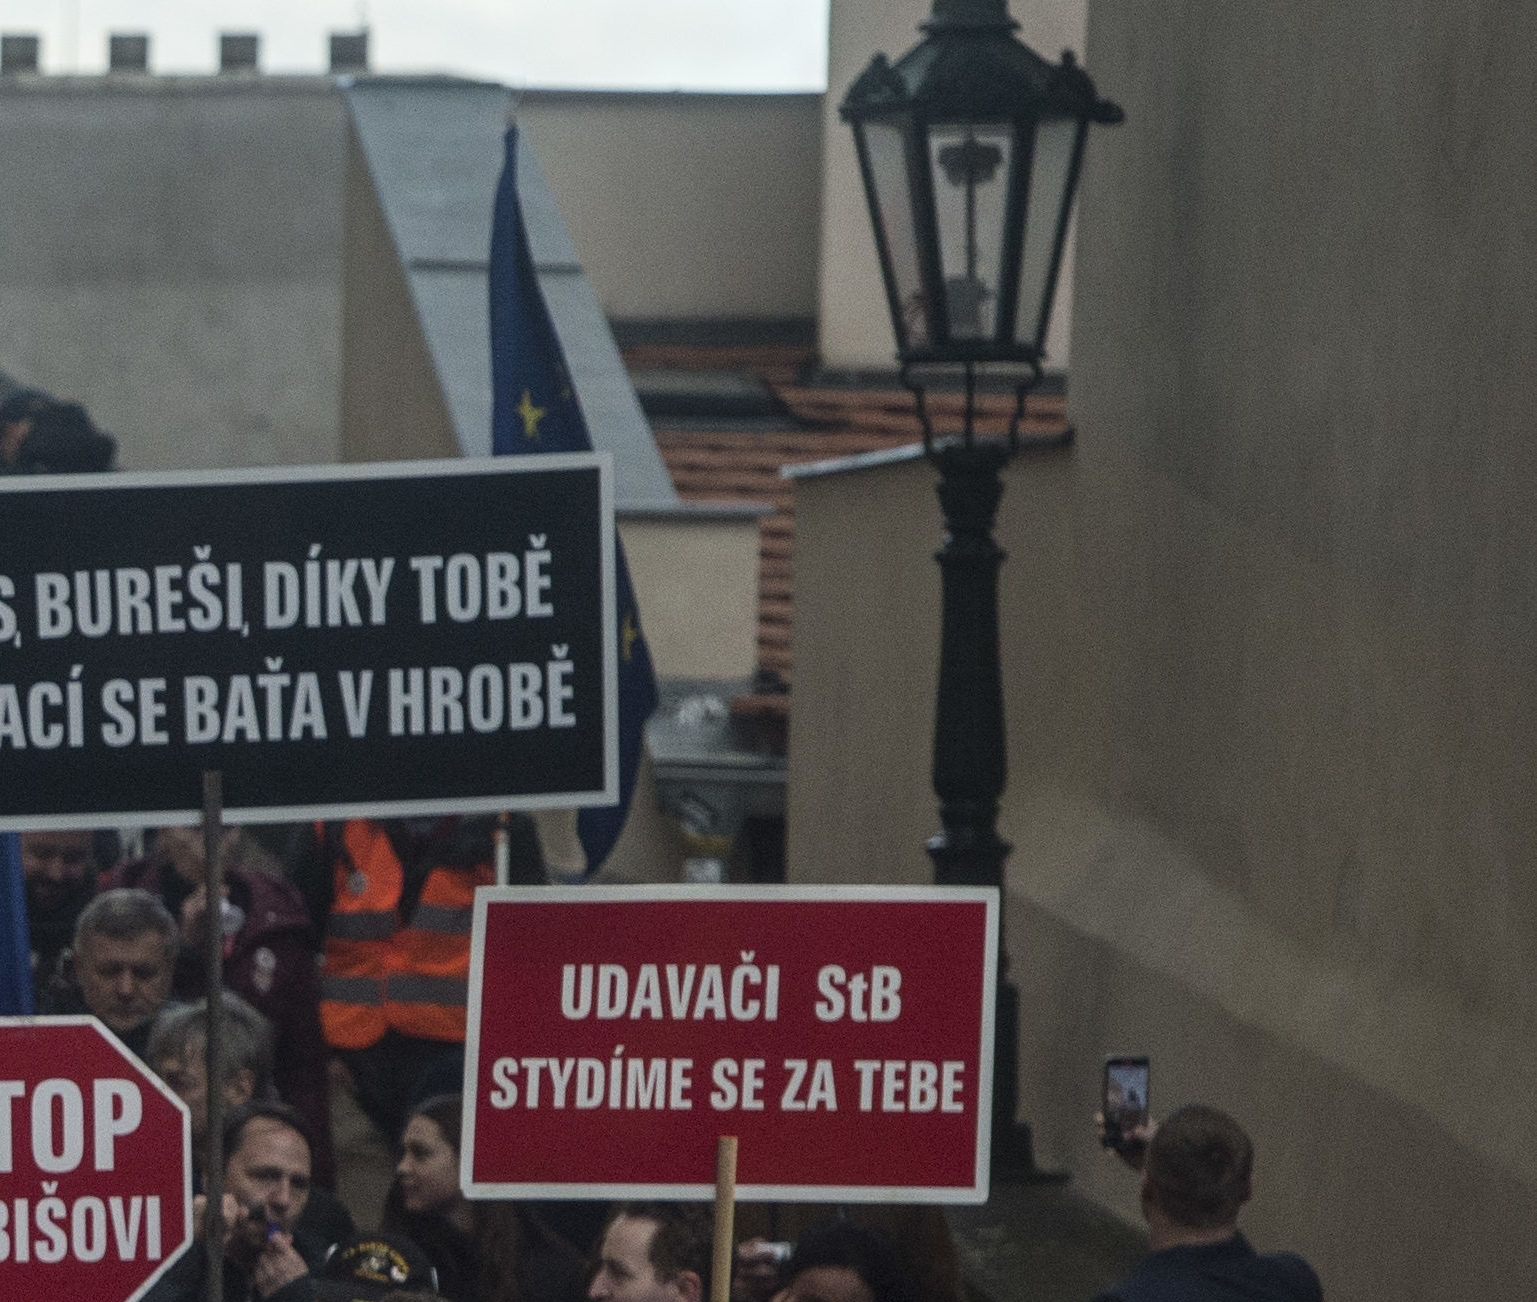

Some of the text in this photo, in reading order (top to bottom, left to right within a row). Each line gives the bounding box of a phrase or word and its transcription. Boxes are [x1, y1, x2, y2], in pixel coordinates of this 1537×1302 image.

[34, 544, 250, 639] BUREŠI,
[263, 542, 396, 630] DÍKY
[409, 533, 555, 625] TOBĚ
[100, 677, 170, 748] SE
[183, 655, 328, 744] BAŤA
[336, 668, 375, 739] V
[387, 643, 577, 738] HROBĚ
[560, 949, 903, 1023] UDAVAČI StB
[490, 1045, 965, 1114] STYDÍME SE ZA TEBE
